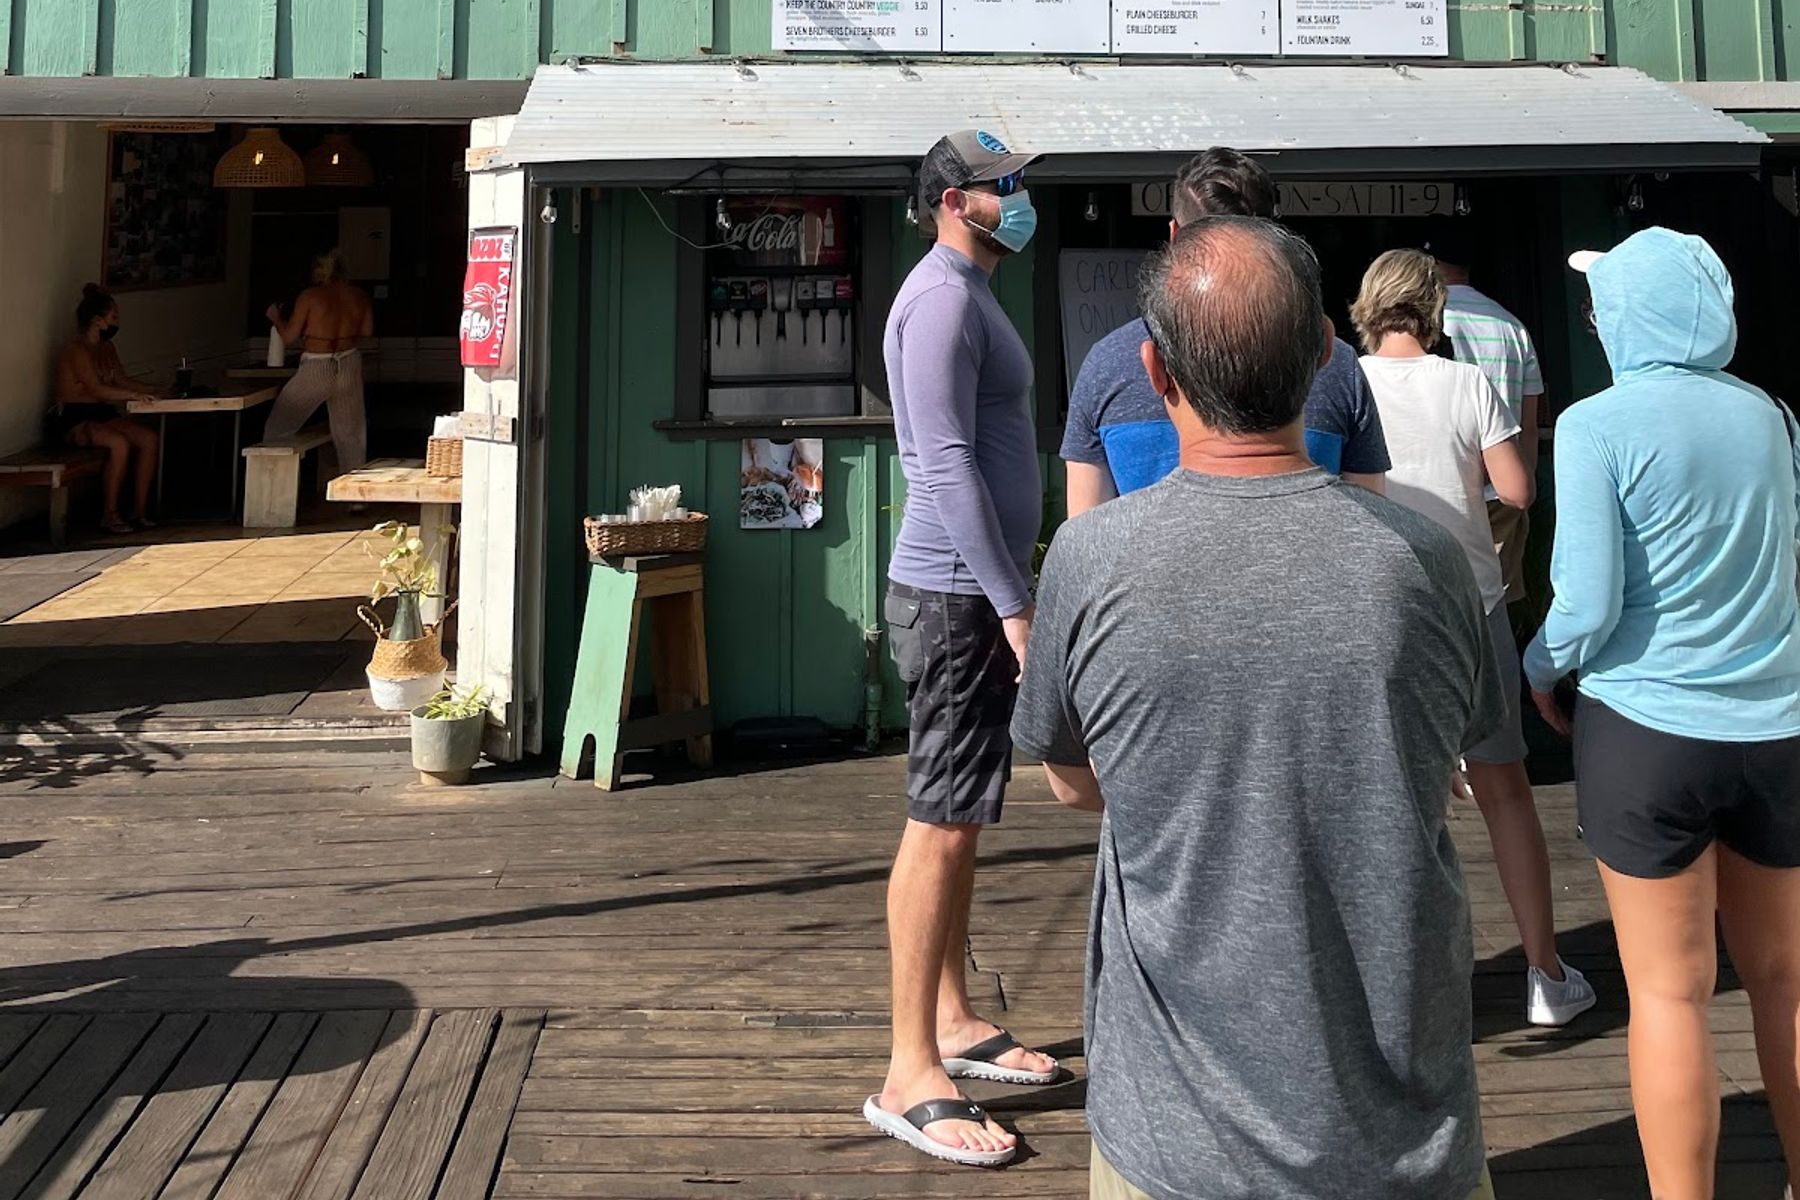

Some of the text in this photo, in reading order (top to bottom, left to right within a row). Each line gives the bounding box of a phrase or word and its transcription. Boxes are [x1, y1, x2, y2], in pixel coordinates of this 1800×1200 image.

[786, 0, 803, 9] KEEP
[804, 0, 816, 9] THE
[817, 0, 845, 10] COUNTRY
[847, 1, 876, 10] COUNTRY
[1126, 10, 1146, 19] PLAIN
[1147, 11, 1198, 20] CHEESEBURGER
[1297, 15, 1313, 24] MILK
[1314, 16, 1340, 24] SHAKES
[786, 27, 807, 36] SEVEN
[808, 27, 843, 36] BROTHERS
[845, 27, 896, 36] CHEESEBURGER
[1126, 25, 1153, 34] GRILLED
[1154, 26, 1177, 35] CHEESE
[1298, 36, 1329, 45] FOUNTAIN
[1330, 36, 1351, 45] DRINK
[1389, 184, 1440, 214] 11-9
